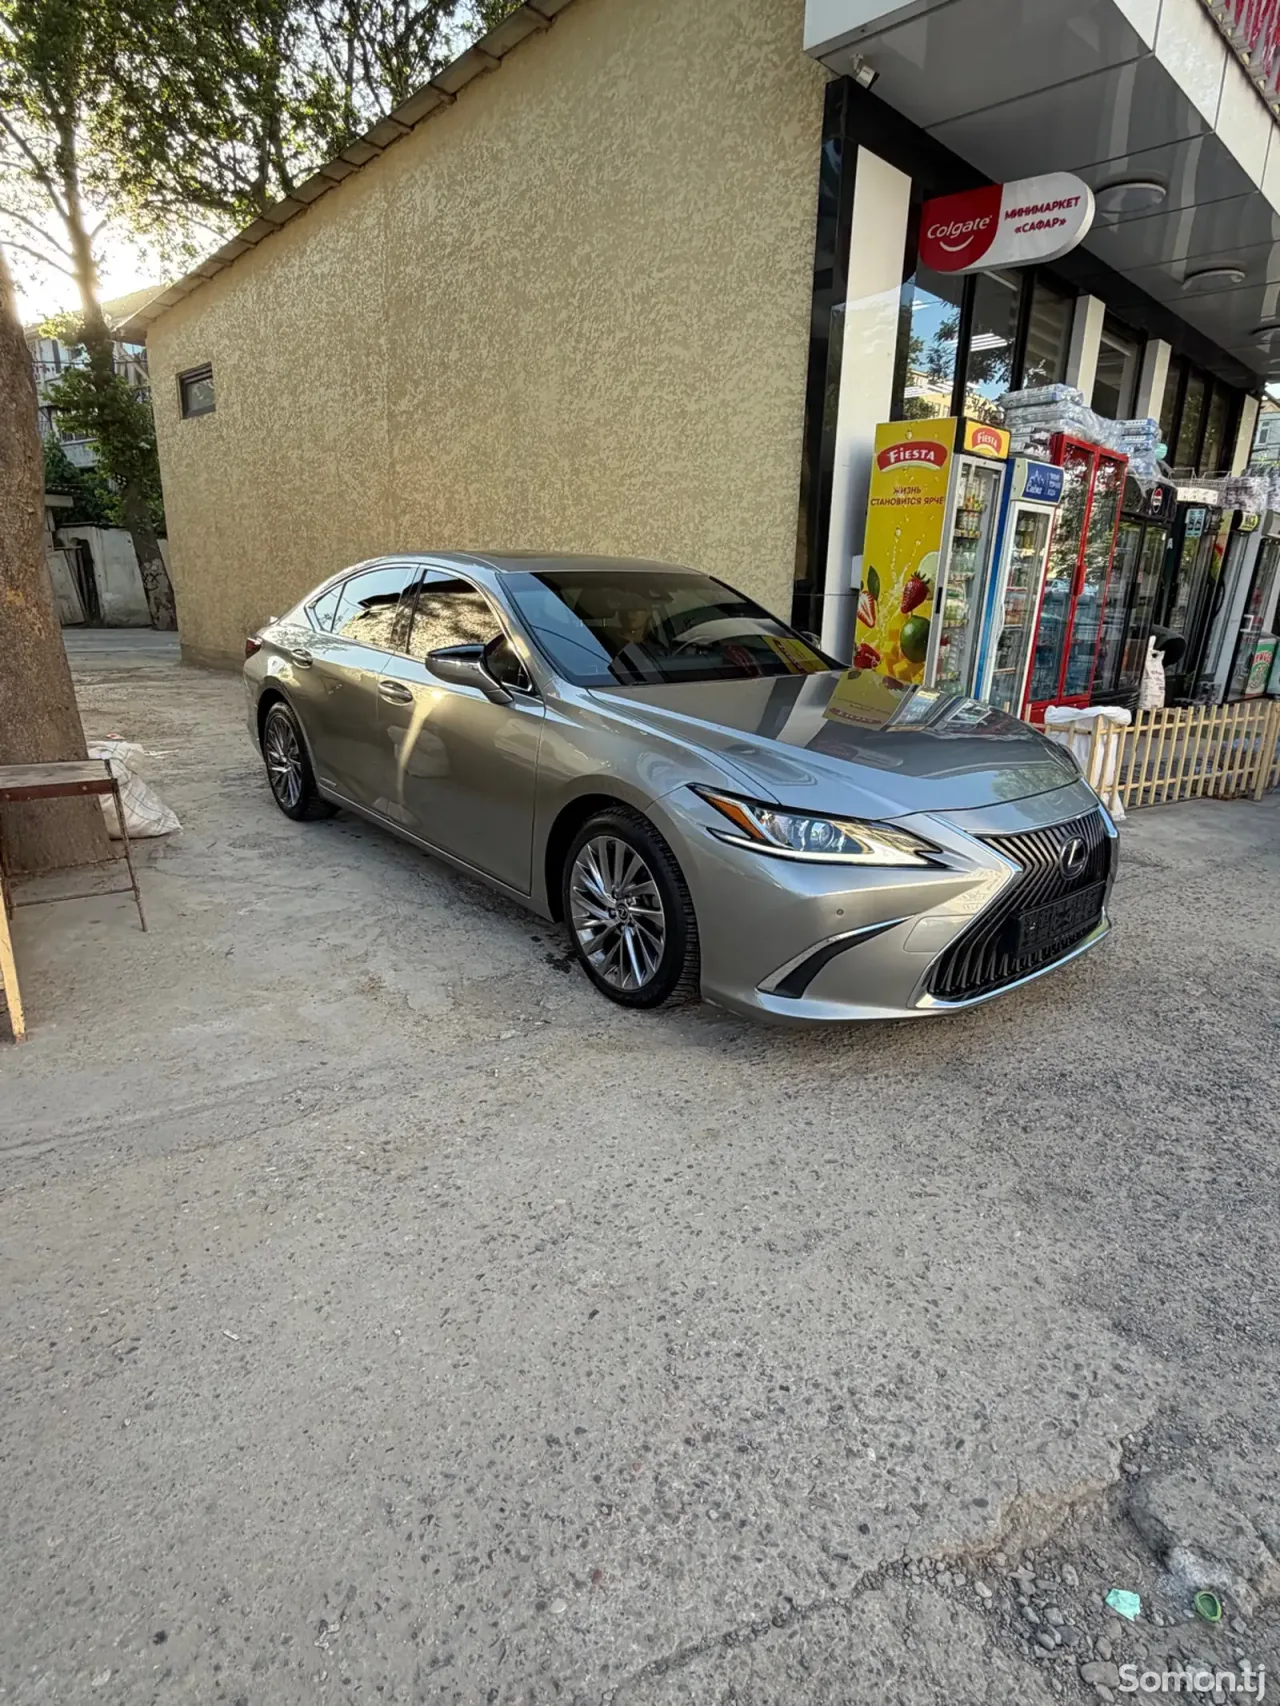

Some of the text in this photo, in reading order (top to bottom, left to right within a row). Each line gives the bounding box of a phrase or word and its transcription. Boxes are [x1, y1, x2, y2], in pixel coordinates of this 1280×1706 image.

[1004, 196, 1081, 220] МИНИМАРКЕТ
[927, 216, 991, 239] Colgate
[1014, 217, 1067, 234] «САФАР»
[893, 486, 922, 495] ЖИЗНЬ
[870, 496, 945, 506] СТАНОВИТСЯ ЯРЧЕ
